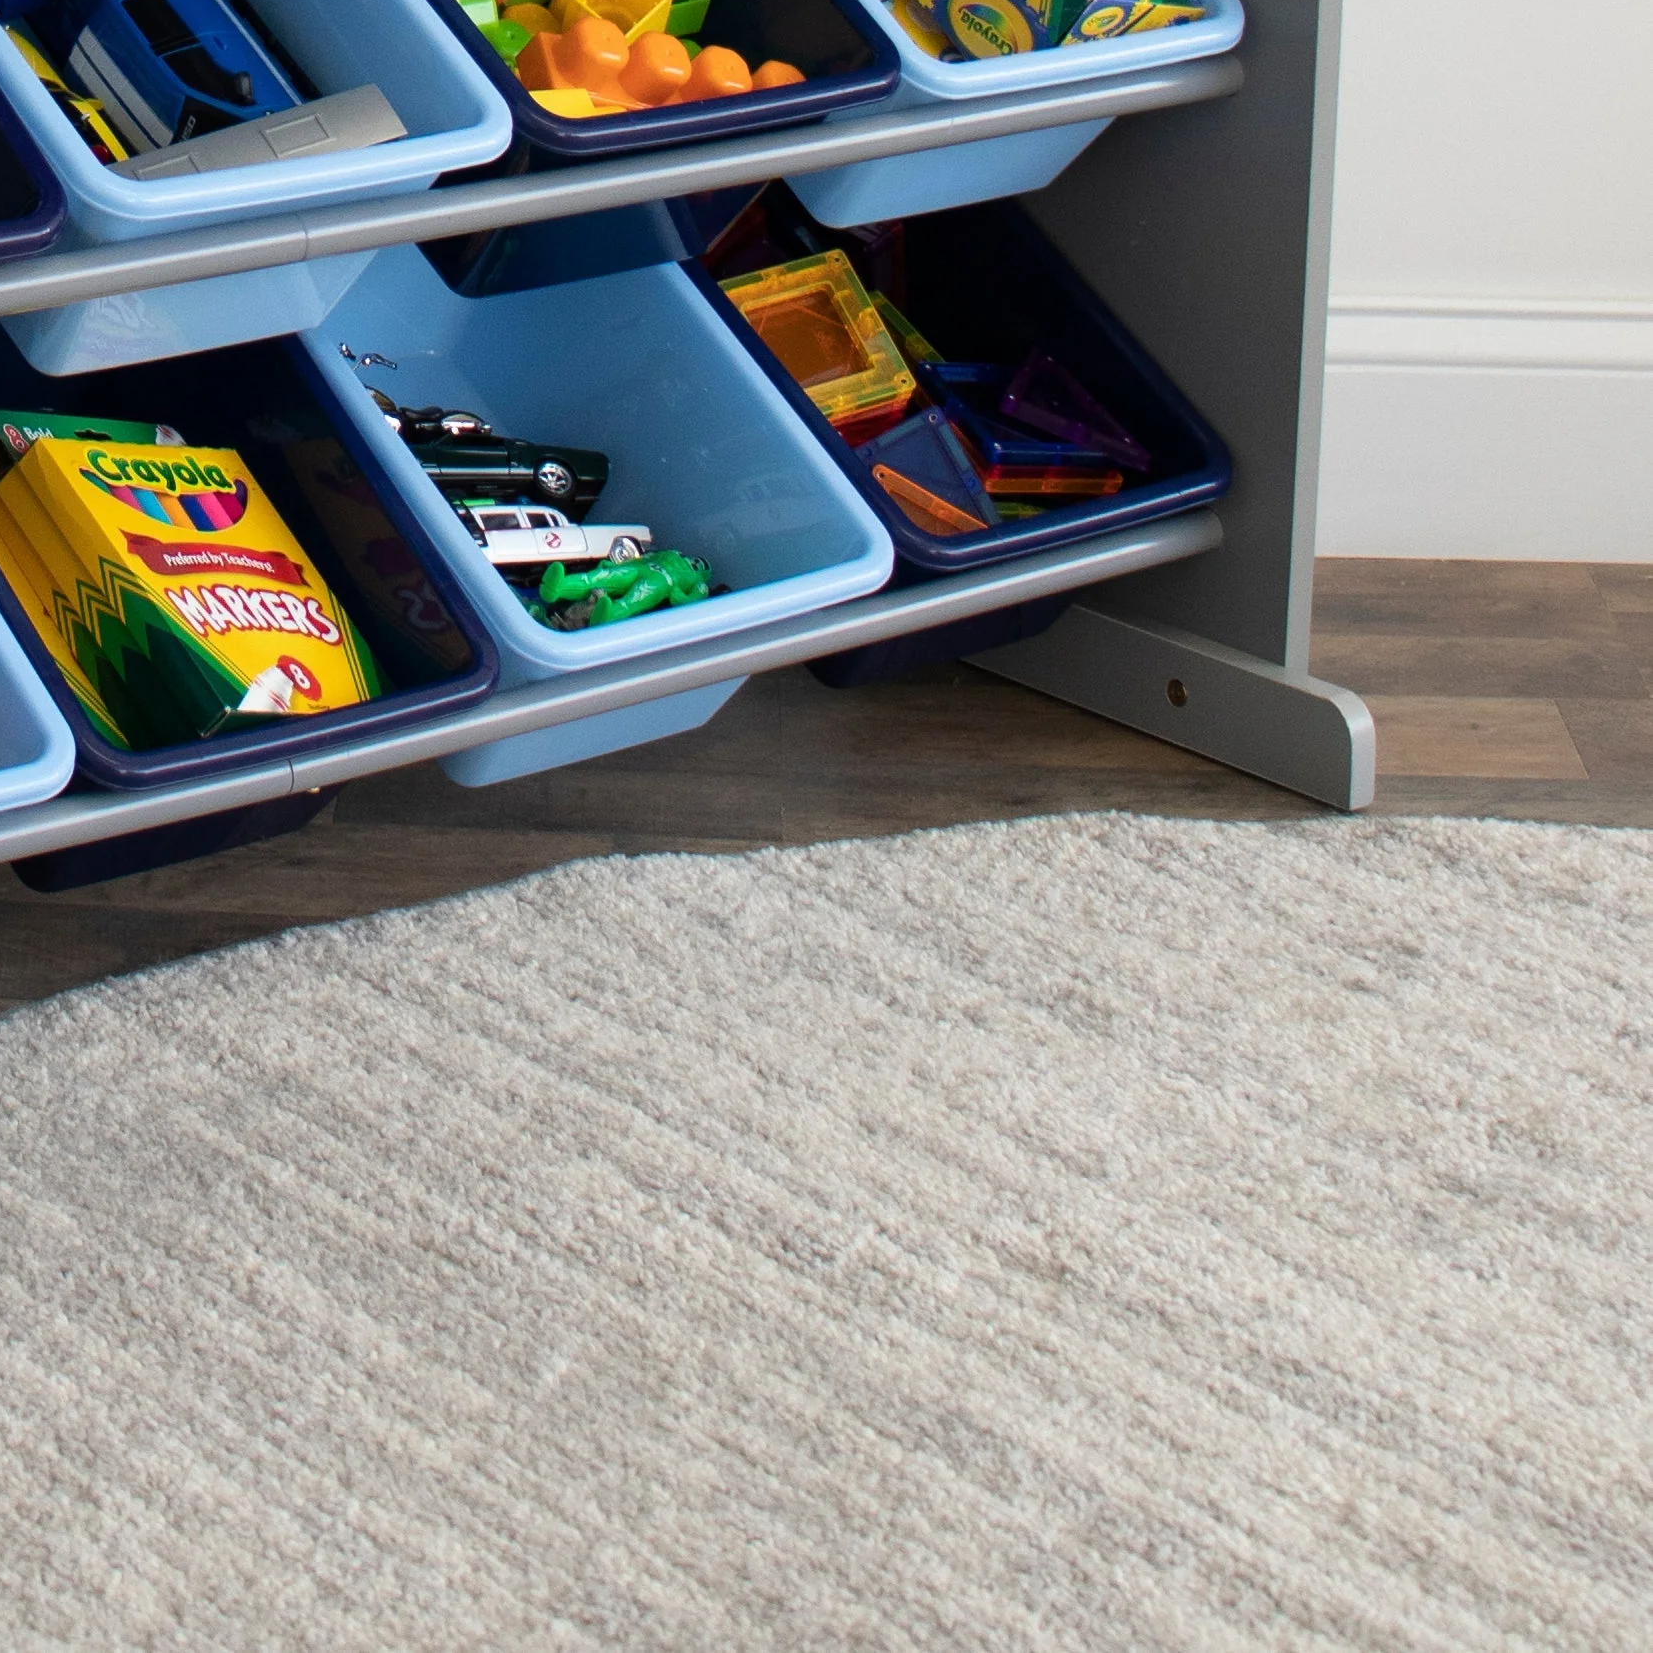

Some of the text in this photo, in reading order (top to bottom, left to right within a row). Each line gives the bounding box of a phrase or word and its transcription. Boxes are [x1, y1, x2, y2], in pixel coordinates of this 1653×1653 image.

[960, 11, 1014, 55] Crayola
[3, 423, 29, 454] 8
[86, 448, 233, 493] Crayola
[163, 551, 276, 575] Preferred by Teachers!
[165, 584, 342, 645] MARKERS
[289, 663, 311, 690] 8
